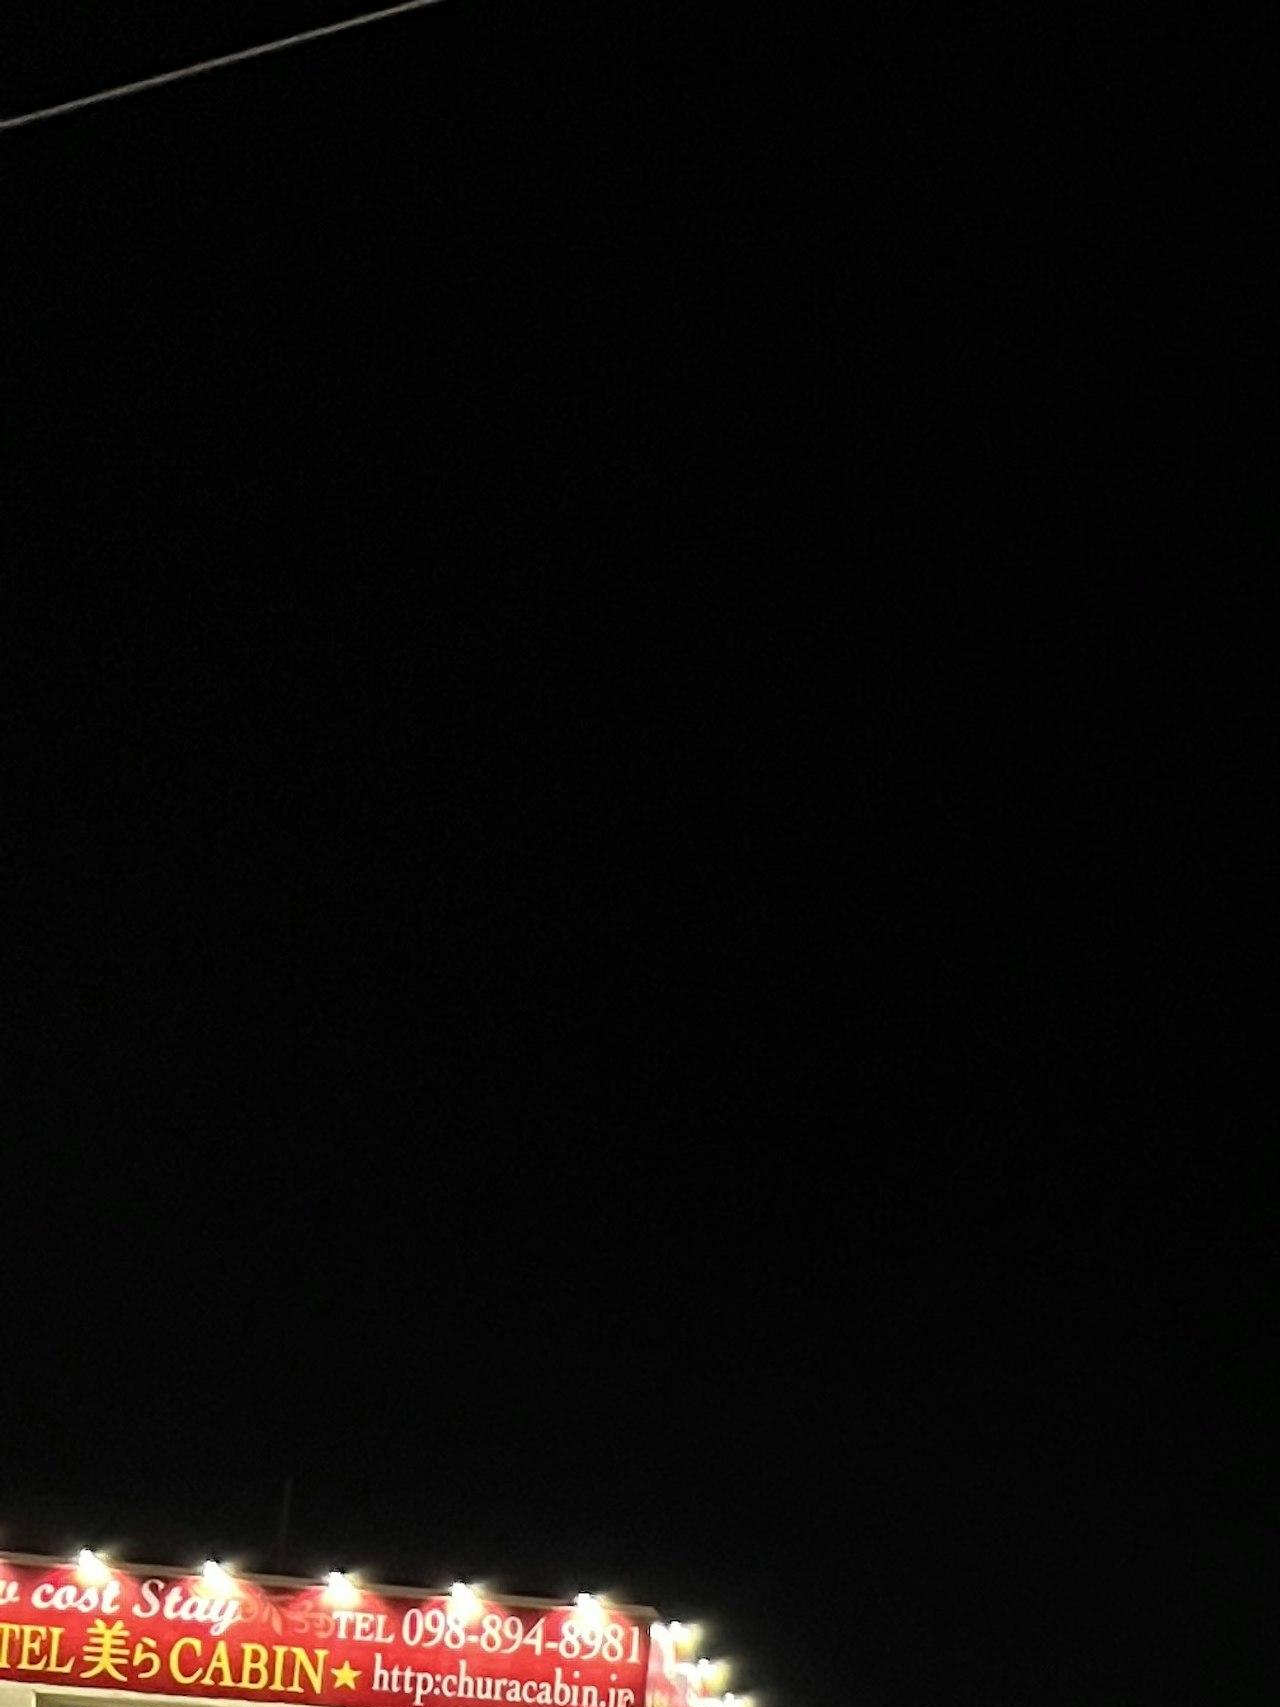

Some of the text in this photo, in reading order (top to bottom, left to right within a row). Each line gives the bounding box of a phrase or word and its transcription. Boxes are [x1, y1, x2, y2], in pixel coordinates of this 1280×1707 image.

[31, 1579, 121, 1614] cost
[132, 1579, 242, 1636] Stay
[332, 1608, 641, 1664] TEL 098-894-8981
[80, 1619, 161, 1682] 美ら
[169, 1637, 328, 1695] CABIN
